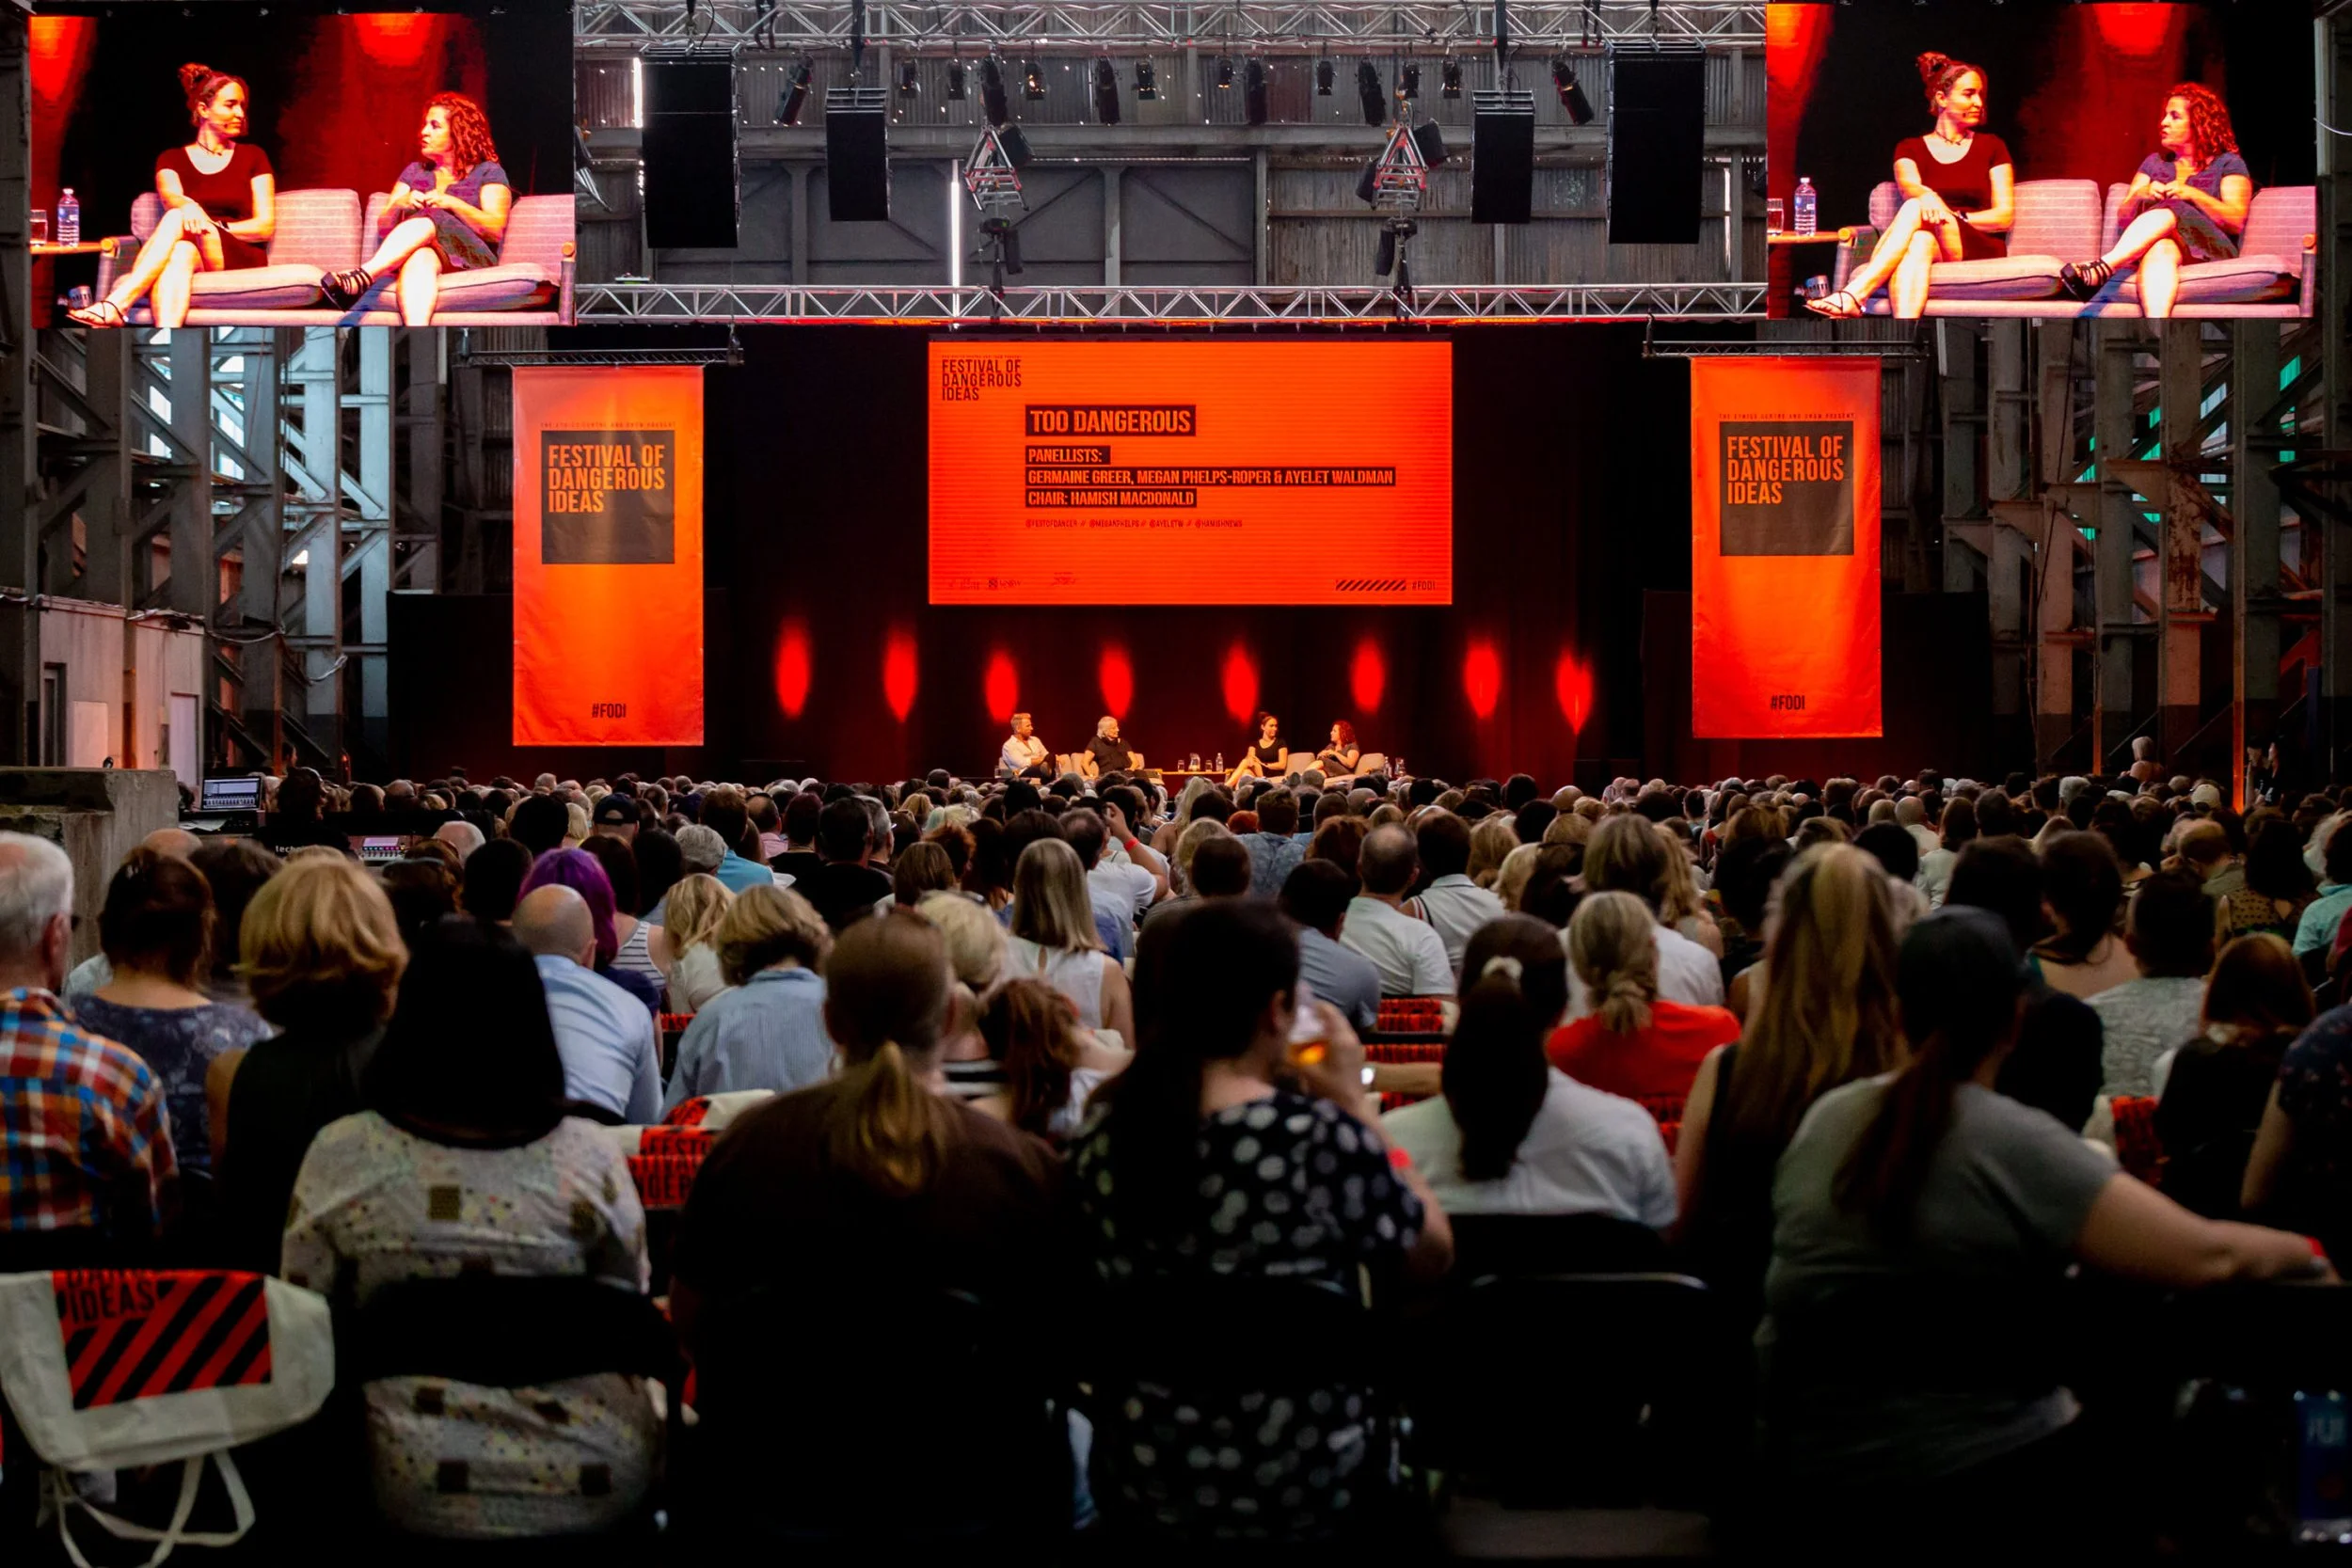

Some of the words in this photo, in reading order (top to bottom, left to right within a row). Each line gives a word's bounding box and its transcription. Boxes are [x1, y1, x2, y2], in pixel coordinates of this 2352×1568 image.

[942, 359, 1001, 372] FESTIVAL
[1006, 359, 1022, 372] OF
[942, 373, 1022, 387] DANGEROUS
[942, 388, 979, 401] IDEAS
[1030, 410, 1069, 433] TOO
[1073, 410, 1191, 433] DANGEROUS
[1727, 436, 1814, 459] FESTIVAL
[1820, 436, 1843, 458] OF
[548, 445, 635, 467] FESTIVAL
[642, 444, 665, 467] OF
[1028, 449, 1103, 463] PANELLISTS:
[1028, 470, 1089, 484] GERMAINE
[1092, 470, 1135, 485] GREER,
[1137, 470, 1180, 484] MEGAN
[1183, 470, 1271, 484] PHELPS-ROPER
[1274, 470, 1282, 484] &
[1285, 470, 1328, 484] AYELET
[1332, 470, 1393, 484] WALDMAN
[1727, 459, 1844, 482] DANGEROUS
[548, 467, 665, 490] DANGEROUS
[1028, 491, 1069, 505] CHAIR:
[1071, 491, 1118, 505] HAMISH
[1120, 491, 1194, 505] MACDONALD
[1727, 482, 1783, 504] IDEAS
[548, 490, 604, 513] IDEAS
[1412, 580, 1436, 591] #FODI
[1770, 695, 1805, 710] #FODI
[592, 704, 627, 719] #FODI
[70, 1279, 155, 1323] IDEAS
